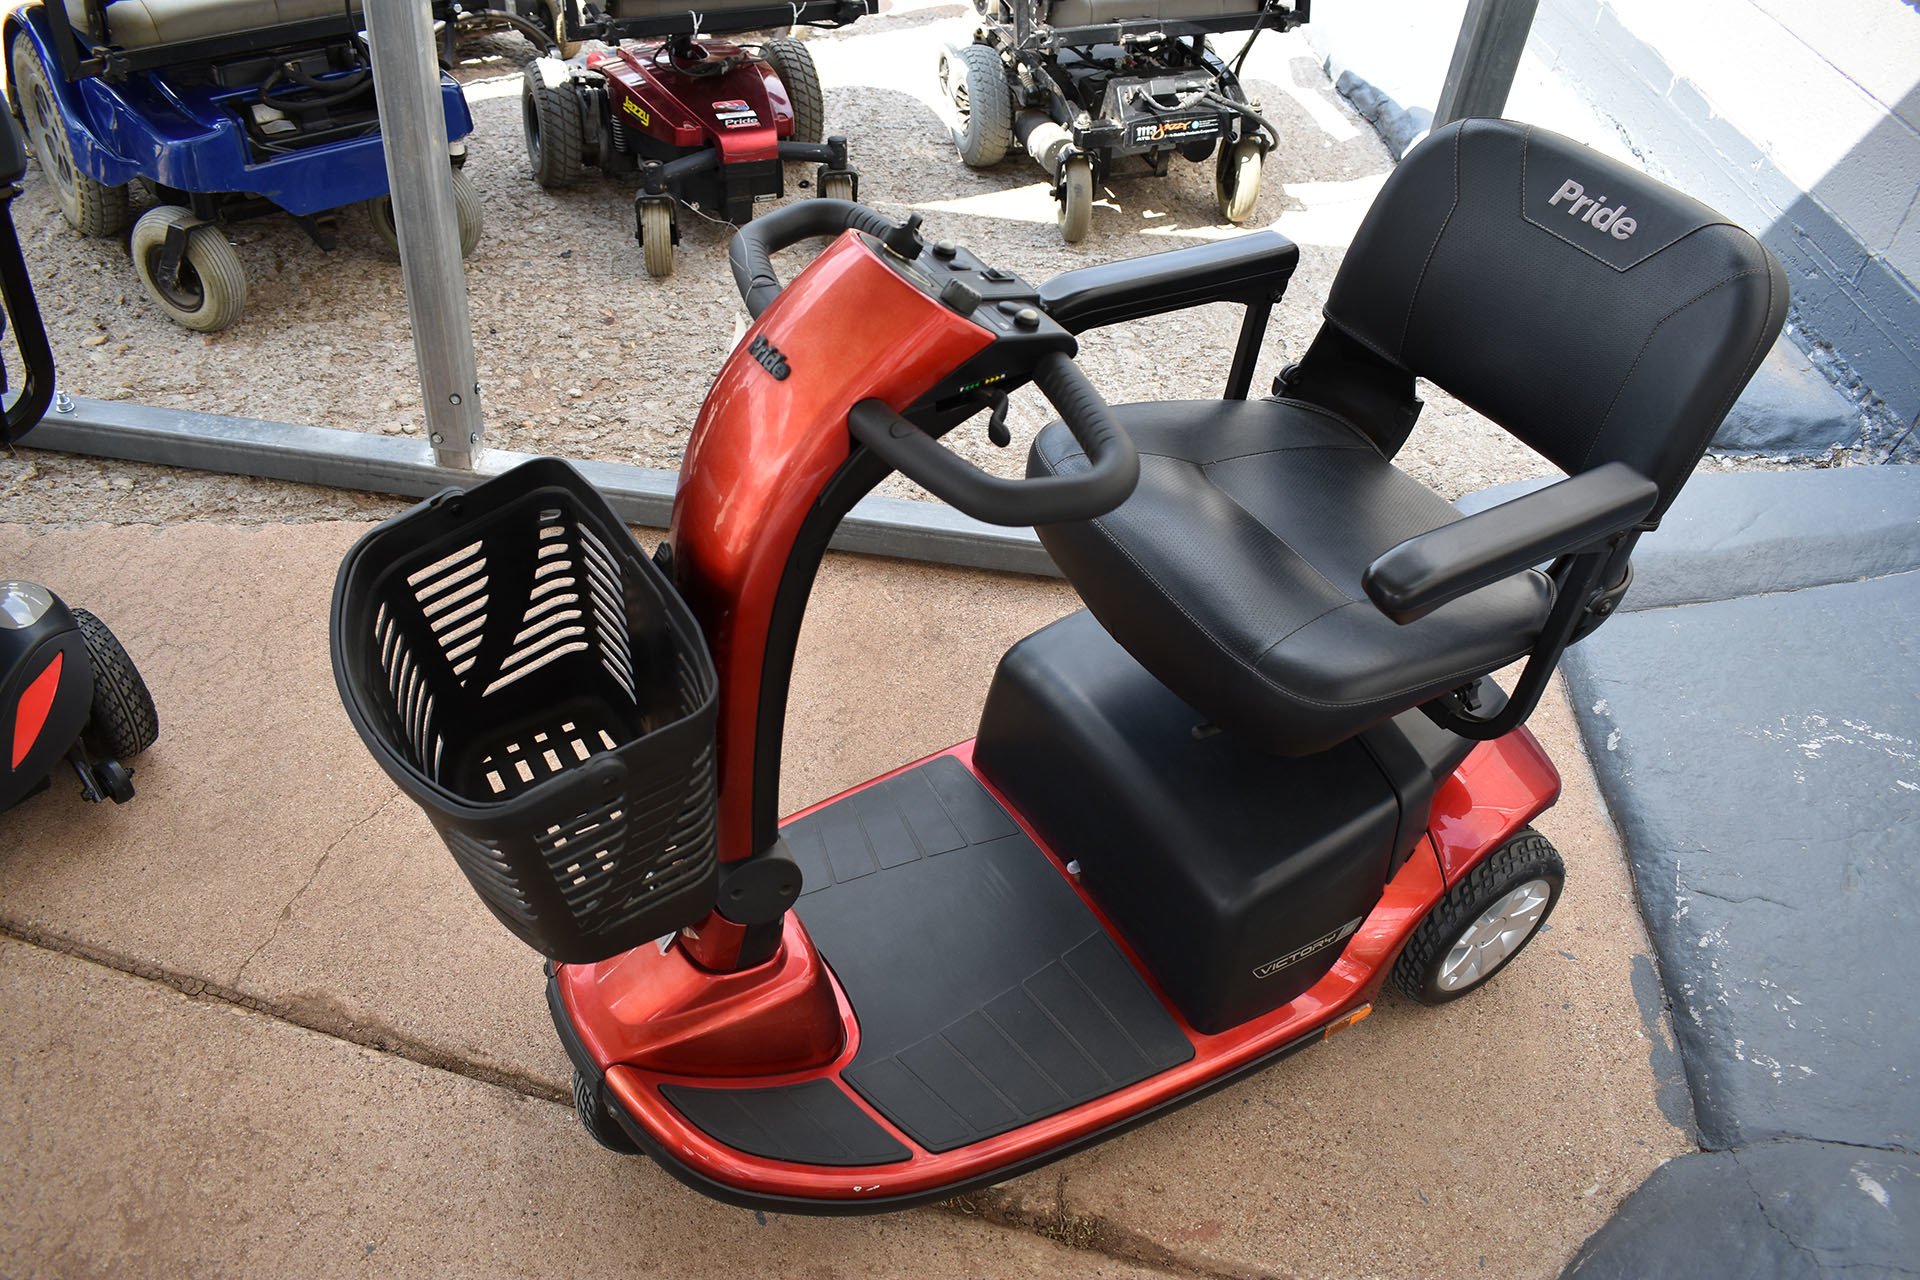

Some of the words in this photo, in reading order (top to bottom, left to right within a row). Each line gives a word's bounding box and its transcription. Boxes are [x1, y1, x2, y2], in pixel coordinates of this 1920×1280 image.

[725, 117, 758, 126] Pride
[1548, 178, 1638, 241] Pride
[749, 334, 791, 380] Pride
[1260, 933, 1336, 975] VICTORY
